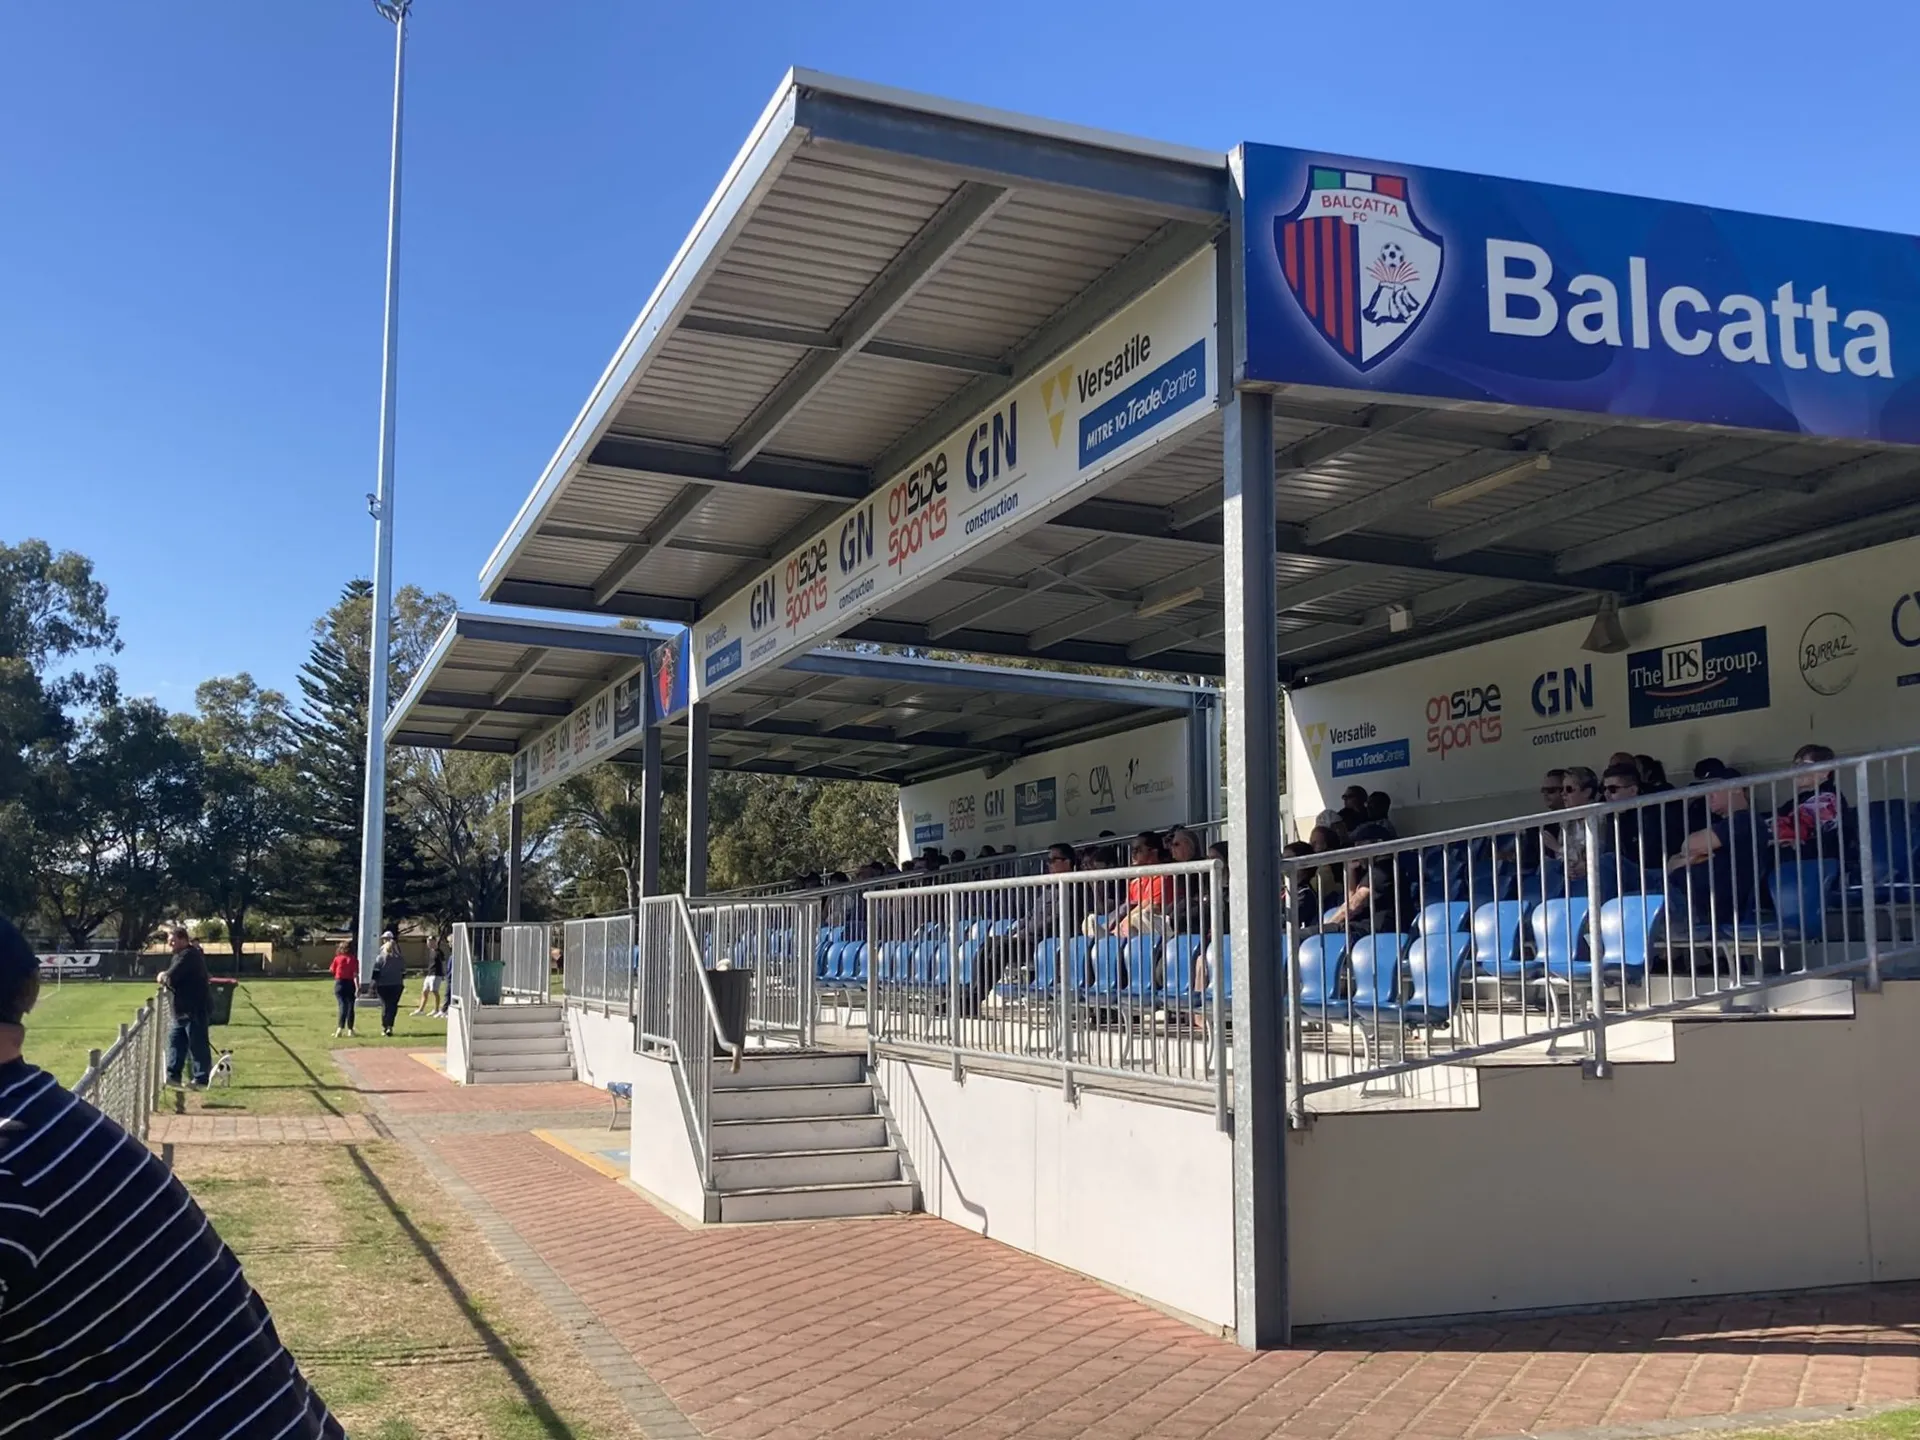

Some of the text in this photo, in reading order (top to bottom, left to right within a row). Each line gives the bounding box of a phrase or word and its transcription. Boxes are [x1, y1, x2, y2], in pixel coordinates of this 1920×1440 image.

[1321, 194, 1399, 218] BALCATTA
[1352, 211, 1368, 222] FC
[1485, 237, 1894, 379] Balcatta
[1077, 333, 1151, 404] Versatile
[965, 400, 1018, 494] GN
[1086, 419, 1114, 451] MITRE
[1114, 411, 1127, 432] 10
[887, 496, 948, 576] sports
[965, 491, 1019, 536] construction
[839, 502, 875, 576] GN
[749, 574, 776, 633] GN
[838, 577, 875, 610] construction
[1531, 662, 1595, 718] GN
[1630, 648, 1763, 688] The IPS group.
[1329, 722, 1377, 745] Versatile
[1426, 715, 1502, 761] sports
[1532, 725, 1597, 746] construction
[984, 787, 1005, 817] GN
